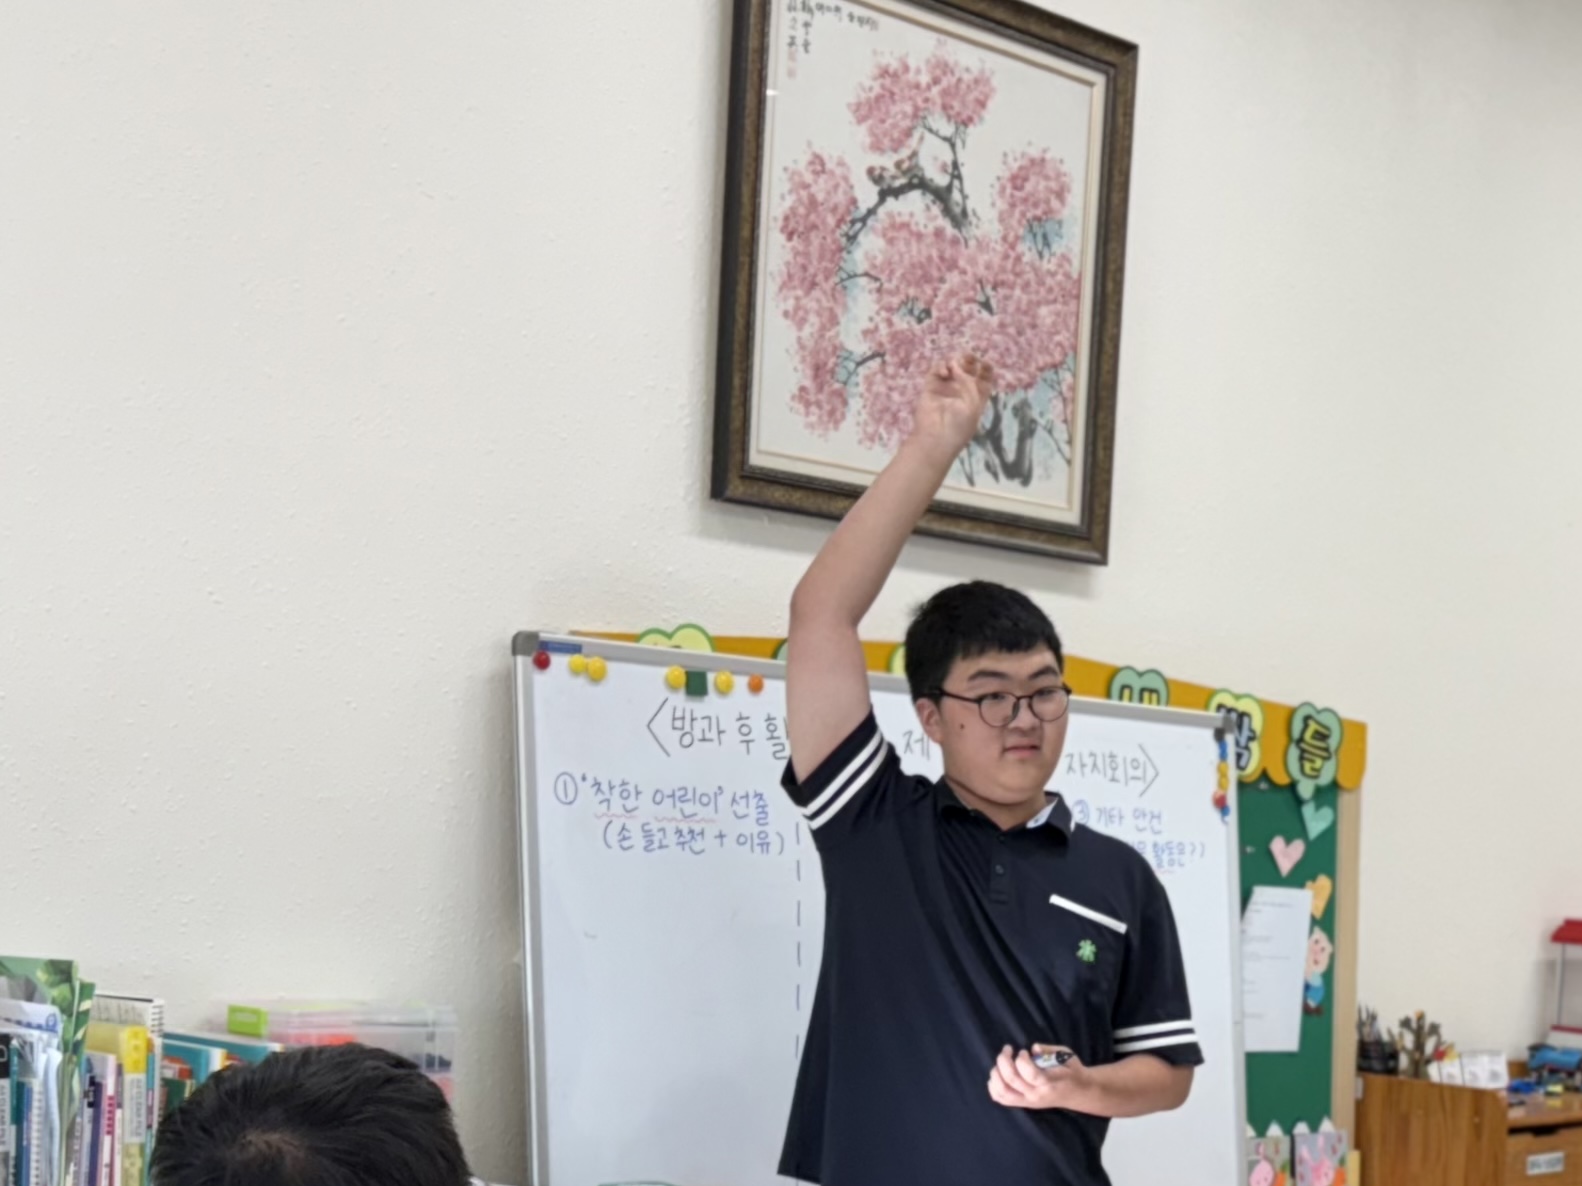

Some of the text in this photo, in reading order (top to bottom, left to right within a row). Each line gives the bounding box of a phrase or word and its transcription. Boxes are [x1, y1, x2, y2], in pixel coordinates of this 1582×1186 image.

[735, 711, 756, 756] 후
[730, 789, 769, 827] 선출
[1096, 806, 1125, 829] 기타
